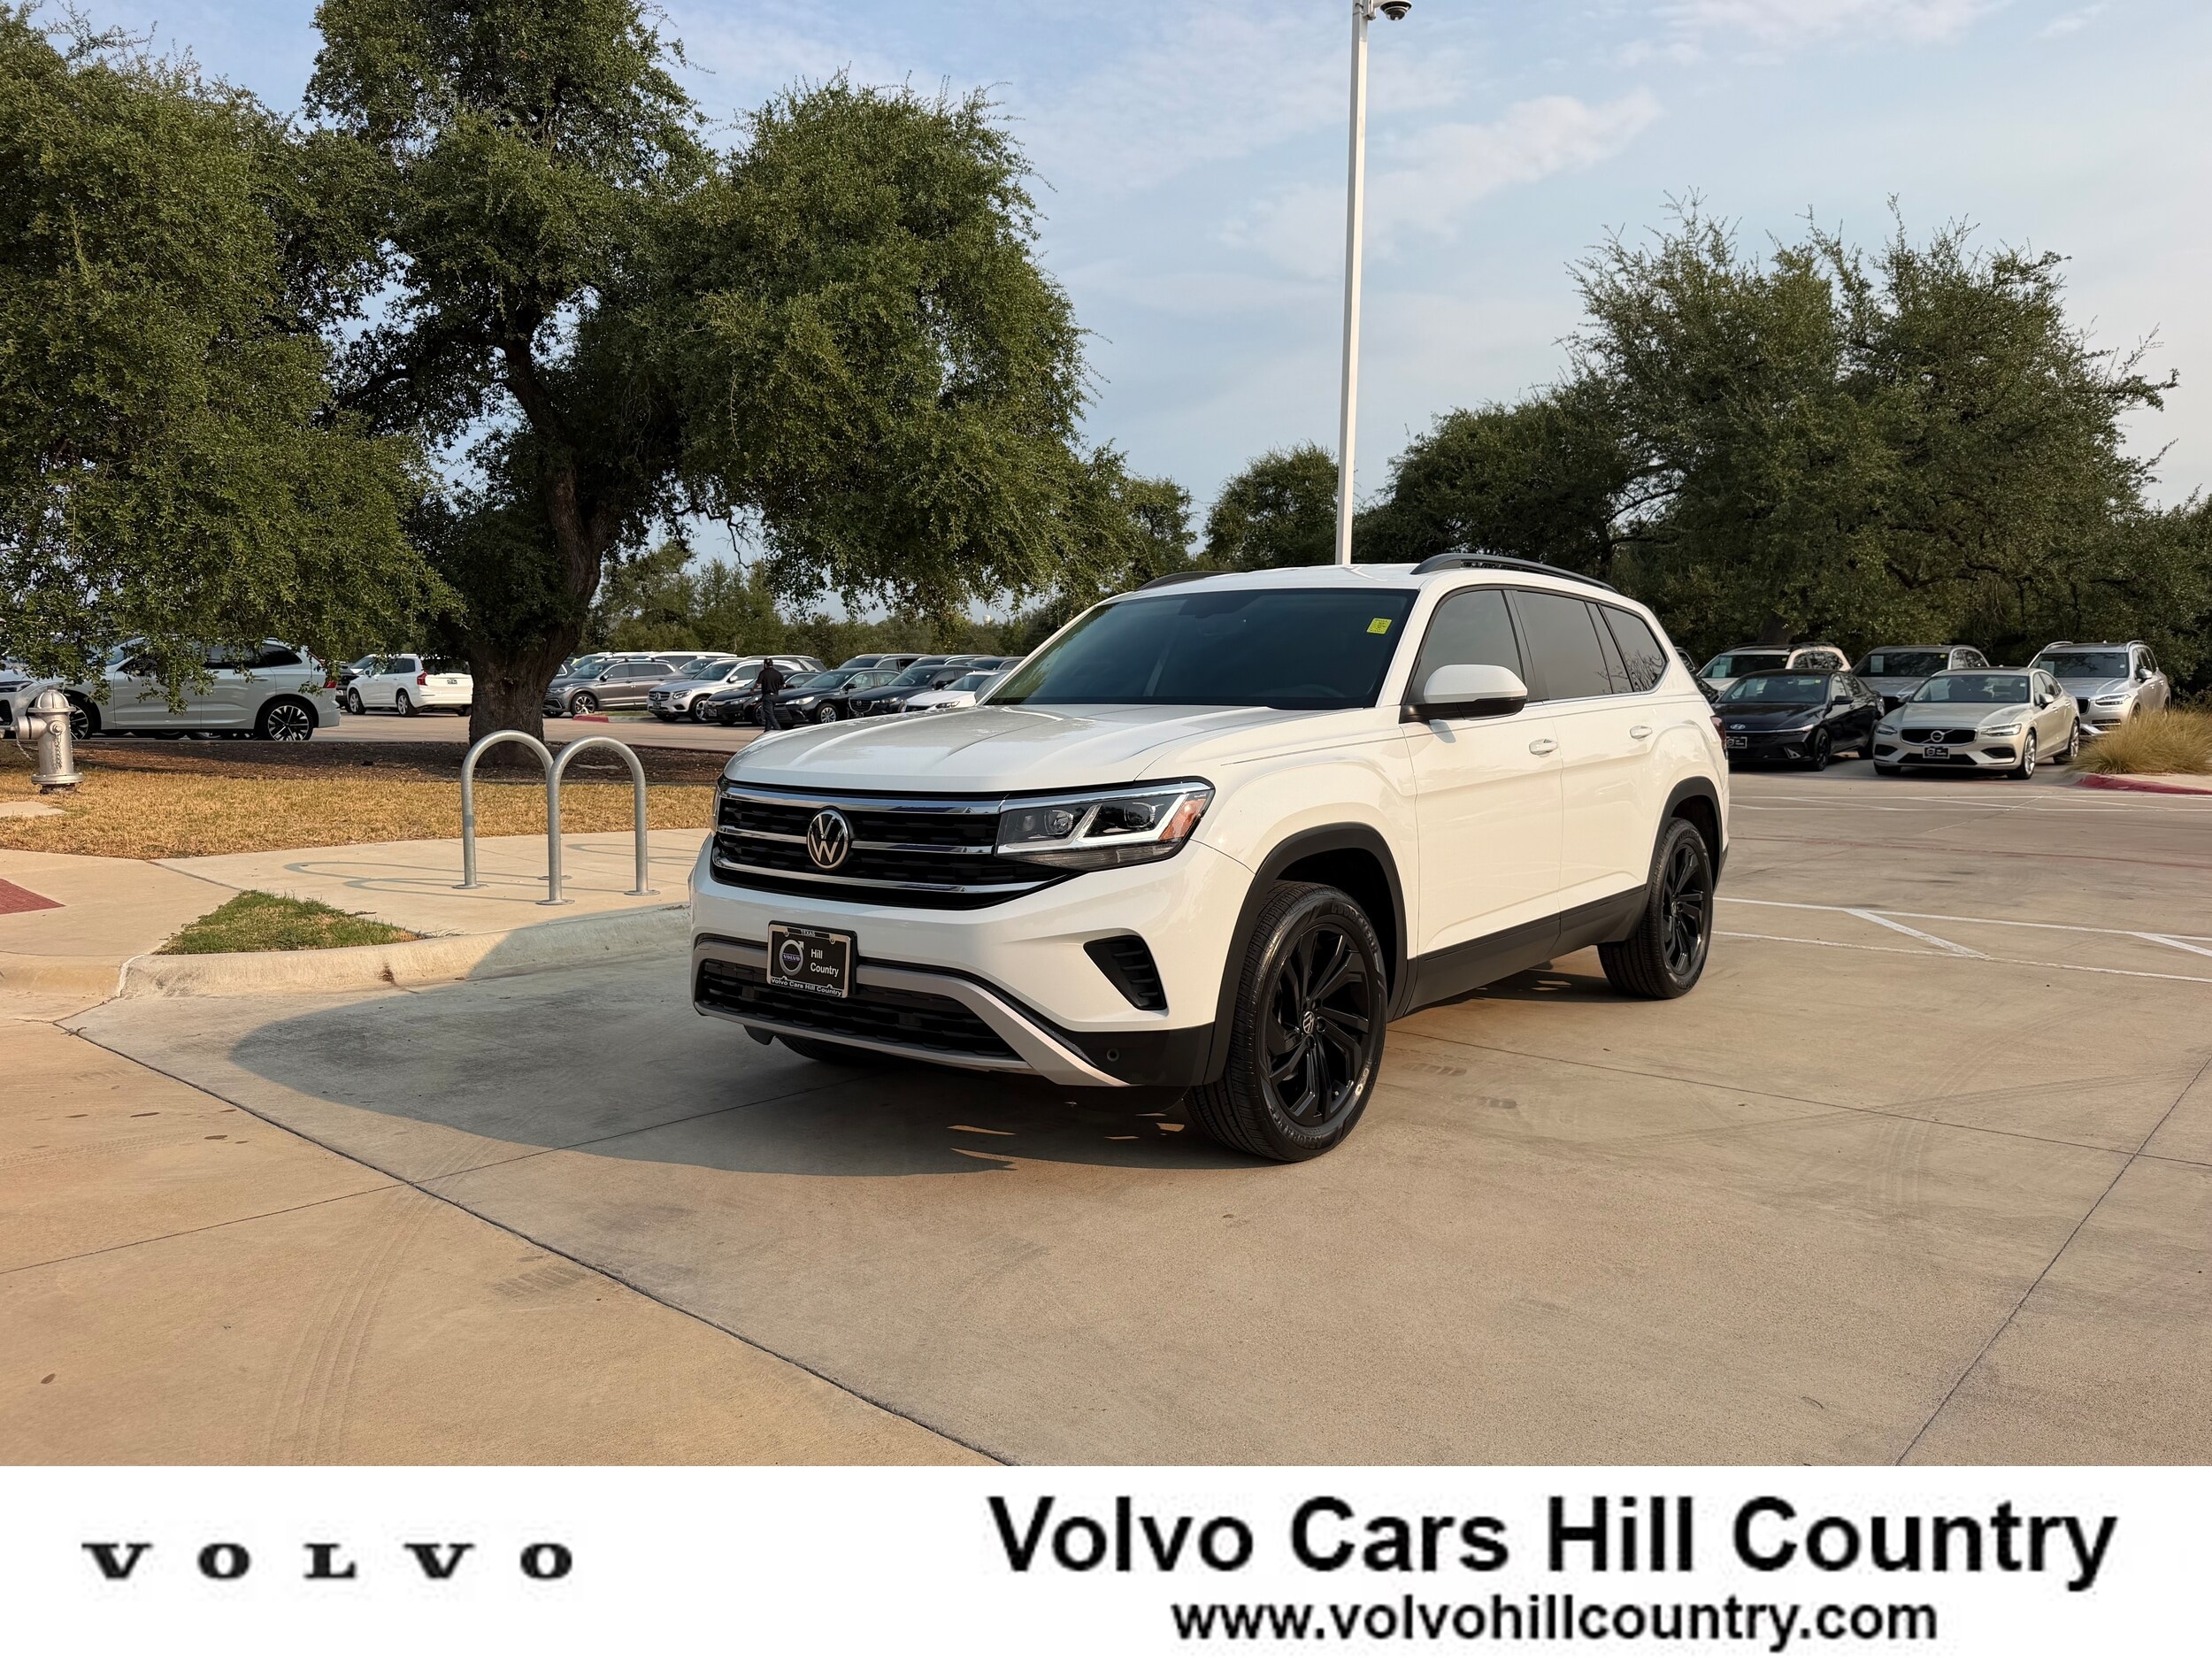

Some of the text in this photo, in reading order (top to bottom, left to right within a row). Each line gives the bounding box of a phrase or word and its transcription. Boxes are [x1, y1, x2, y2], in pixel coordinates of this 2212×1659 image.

[810, 949, 823, 959] Hill
[810, 962, 839, 977] Country
[771, 977, 788, 986] Volvo
[789, 979, 804, 989] Cars
[817, 986, 842, 996] Country
